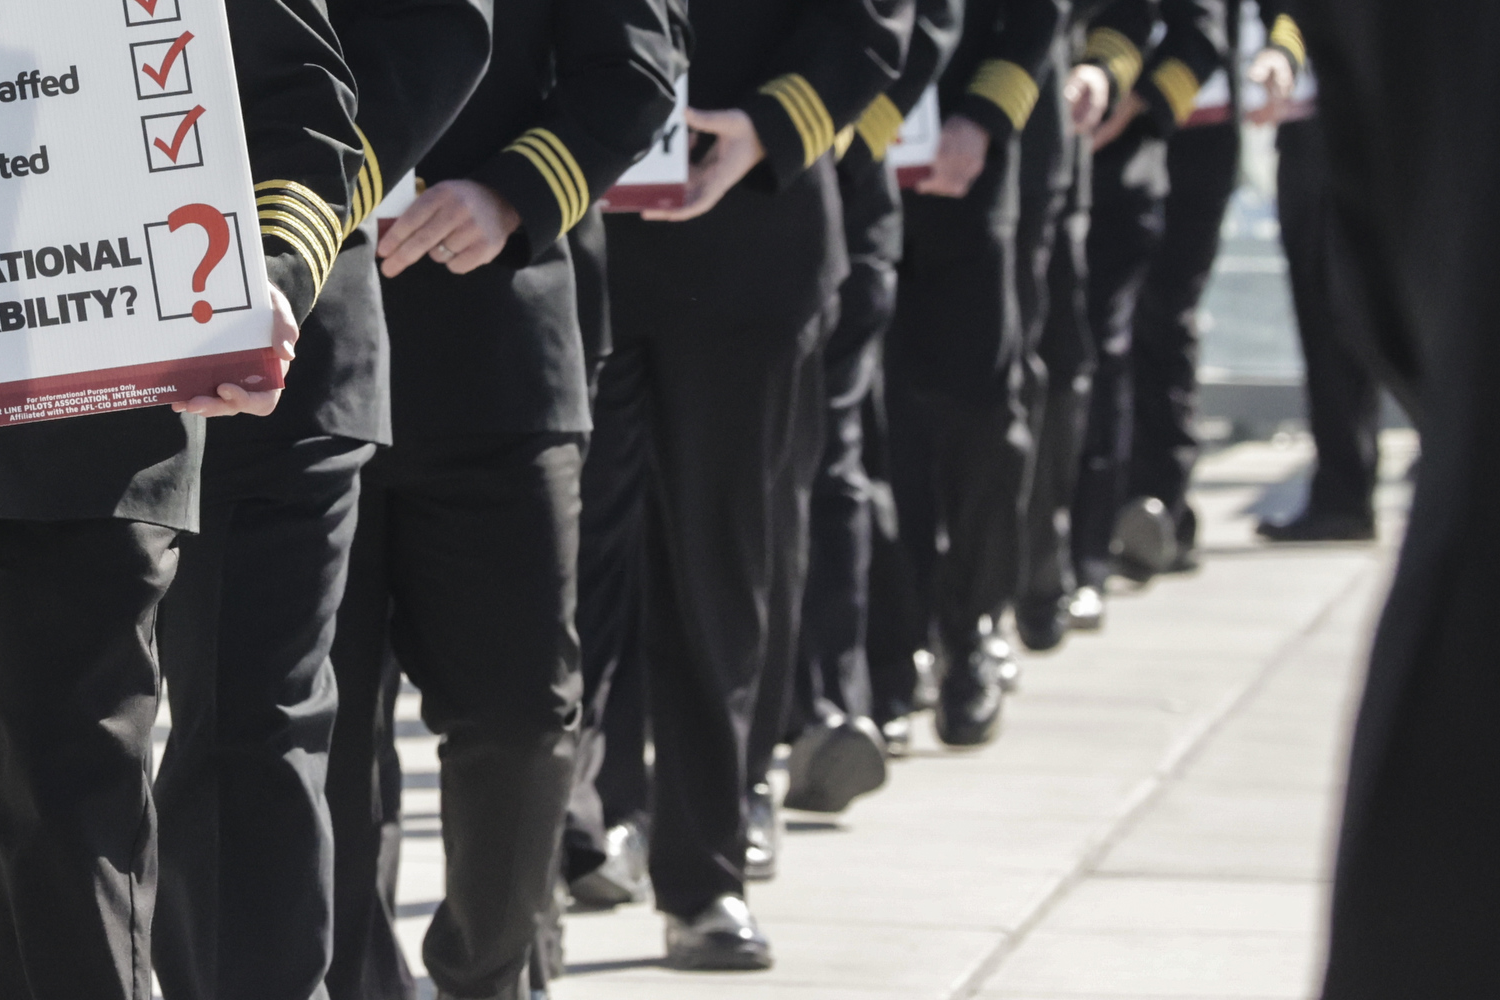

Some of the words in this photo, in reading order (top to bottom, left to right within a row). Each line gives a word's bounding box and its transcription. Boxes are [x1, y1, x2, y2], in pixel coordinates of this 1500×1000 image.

[4, 406, 22, 414] LINE
[24, 402, 52, 411] PILOTS
[112, 385, 177, 400] INTERNATIONAL
[26, 396, 38, 404] For
[39, 389, 86, 402] Informational
[87, 386, 119, 396] Purposes
[120, 384, 135, 392] Only
[9, 410, 45, 421] Affiliated
[47, 407, 64, 416] with
[65, 406, 79, 414] the
[80, 402, 111, 412] AFL-CIO
